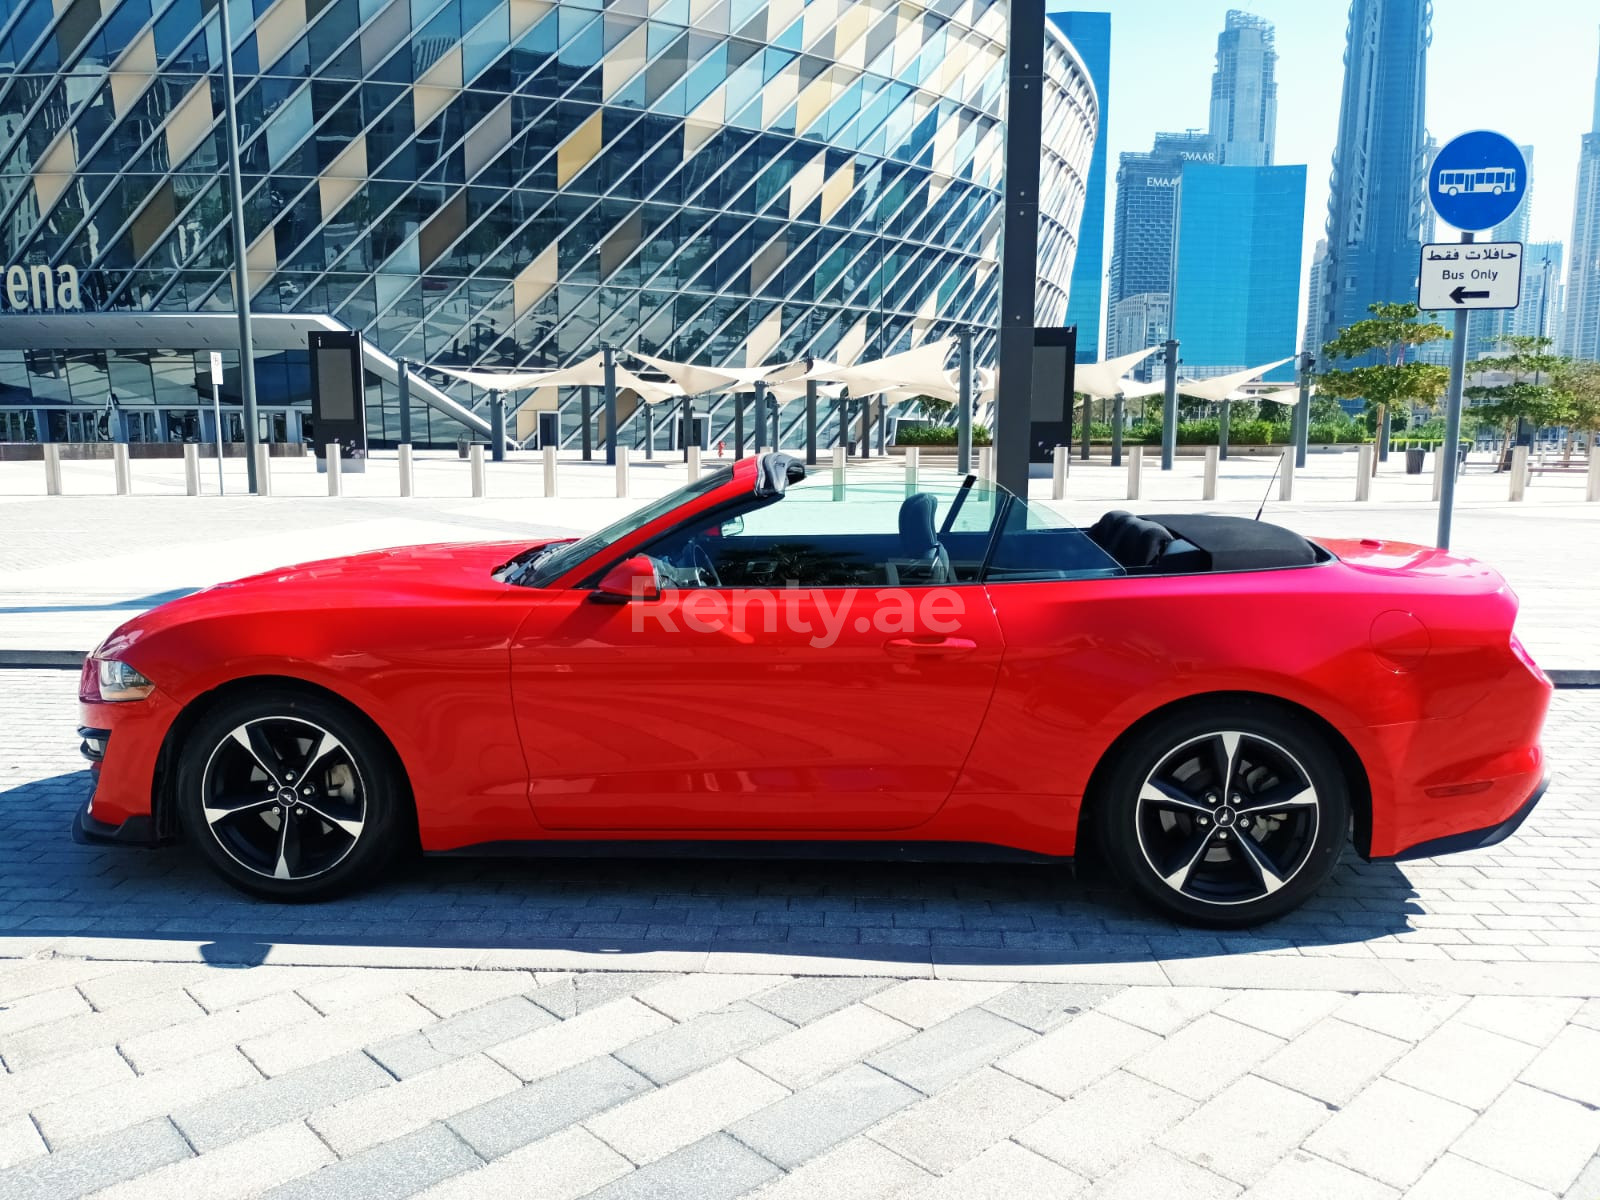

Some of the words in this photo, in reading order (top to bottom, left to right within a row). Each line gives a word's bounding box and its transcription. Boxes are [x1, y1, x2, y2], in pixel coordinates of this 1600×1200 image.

[1426, 249, 1460, 261] فقط
[1465, 248, 1518, 260] حافلات
[1442, 269, 1465, 280] Bus
[1471, 269, 1498, 281] Only
